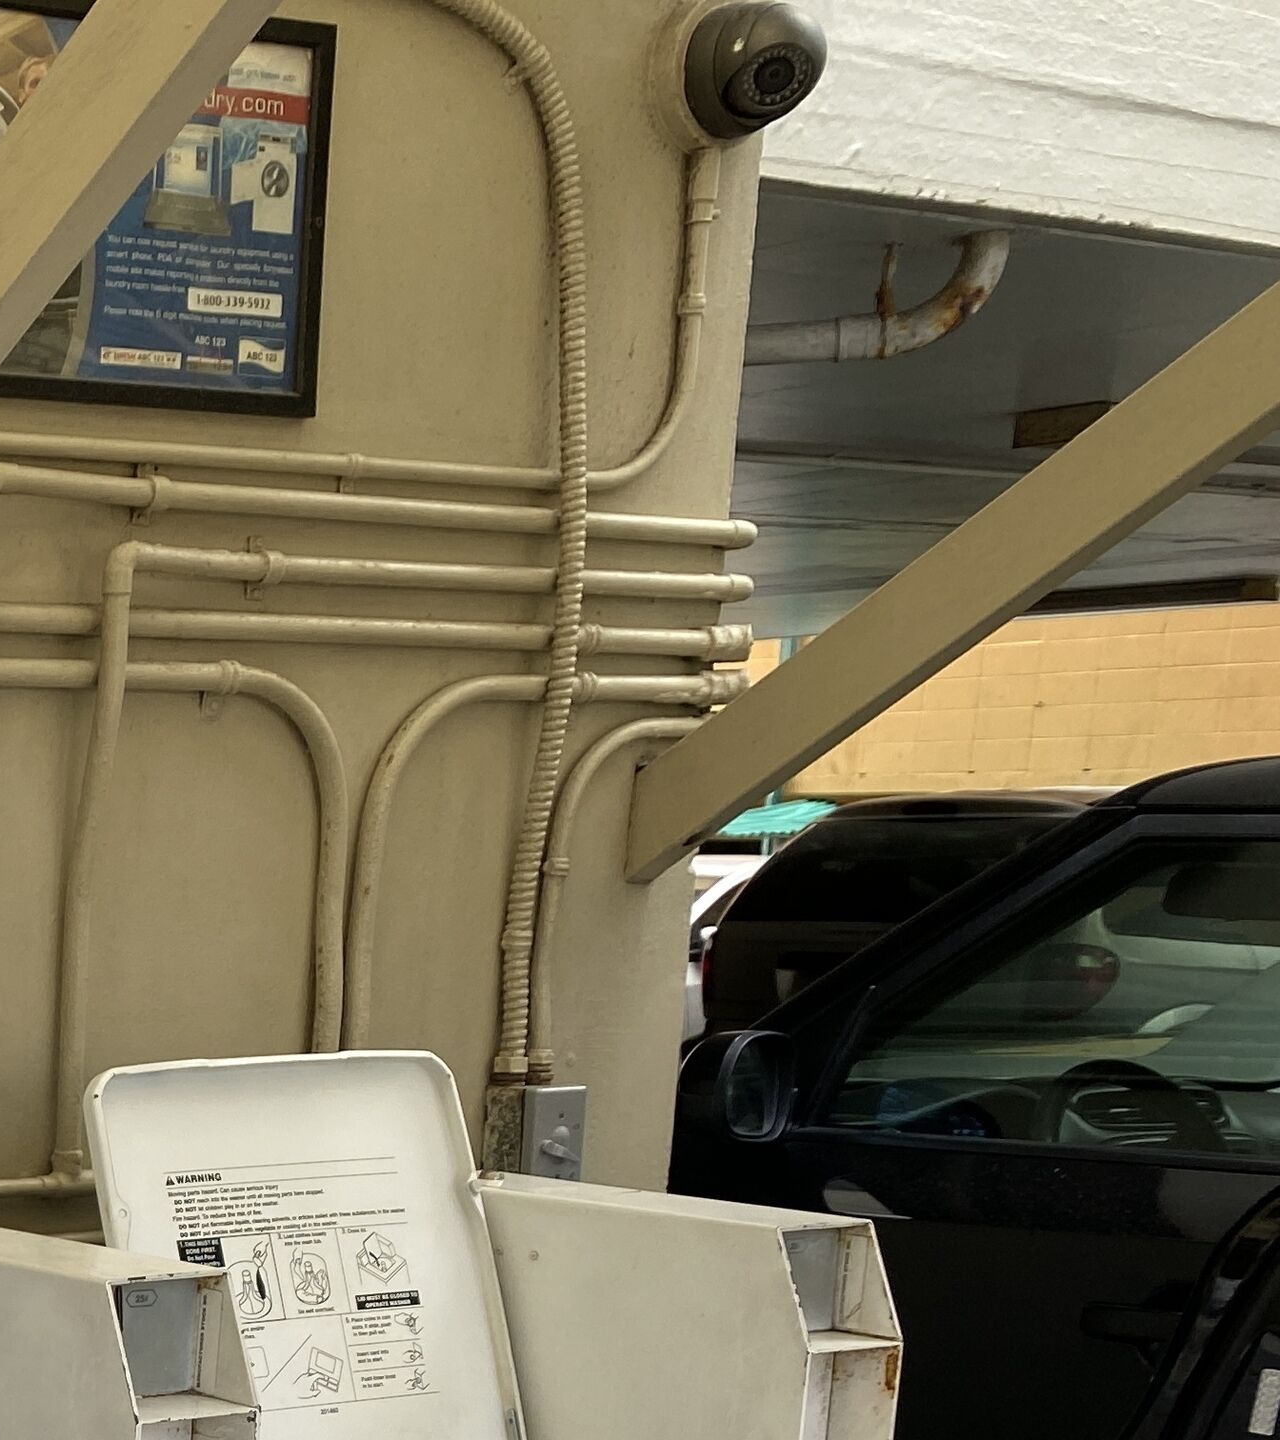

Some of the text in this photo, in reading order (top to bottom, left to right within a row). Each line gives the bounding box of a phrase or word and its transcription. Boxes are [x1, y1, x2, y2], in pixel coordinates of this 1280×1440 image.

[205, 88, 284, 116] dry.com
[195, 335, 226, 347] ABC 123
[246, 351, 278, 362] ABC 123
[176, 1173, 222, 1184] WARNING
